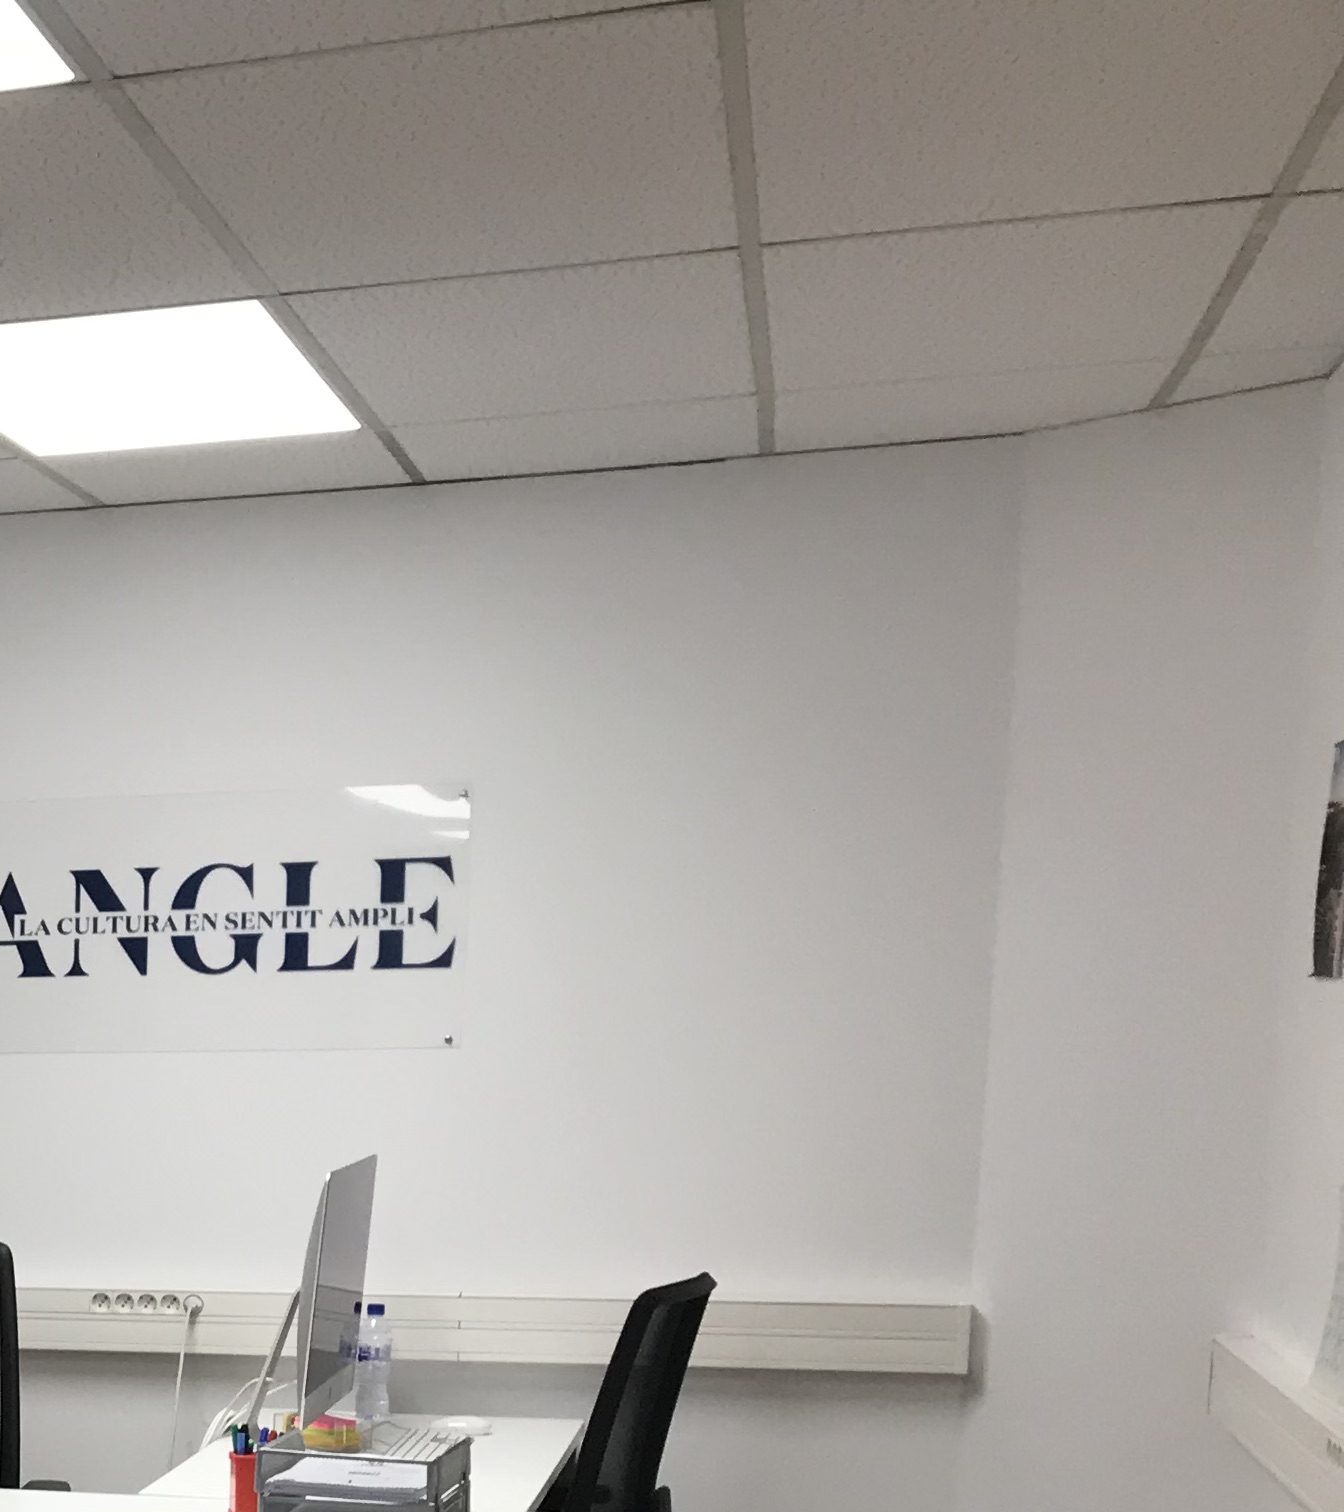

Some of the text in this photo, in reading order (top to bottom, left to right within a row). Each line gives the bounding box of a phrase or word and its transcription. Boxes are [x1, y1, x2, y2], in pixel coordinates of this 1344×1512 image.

[19, 906, 415, 937] LA CULTURA EN SENTIT AMPLI
